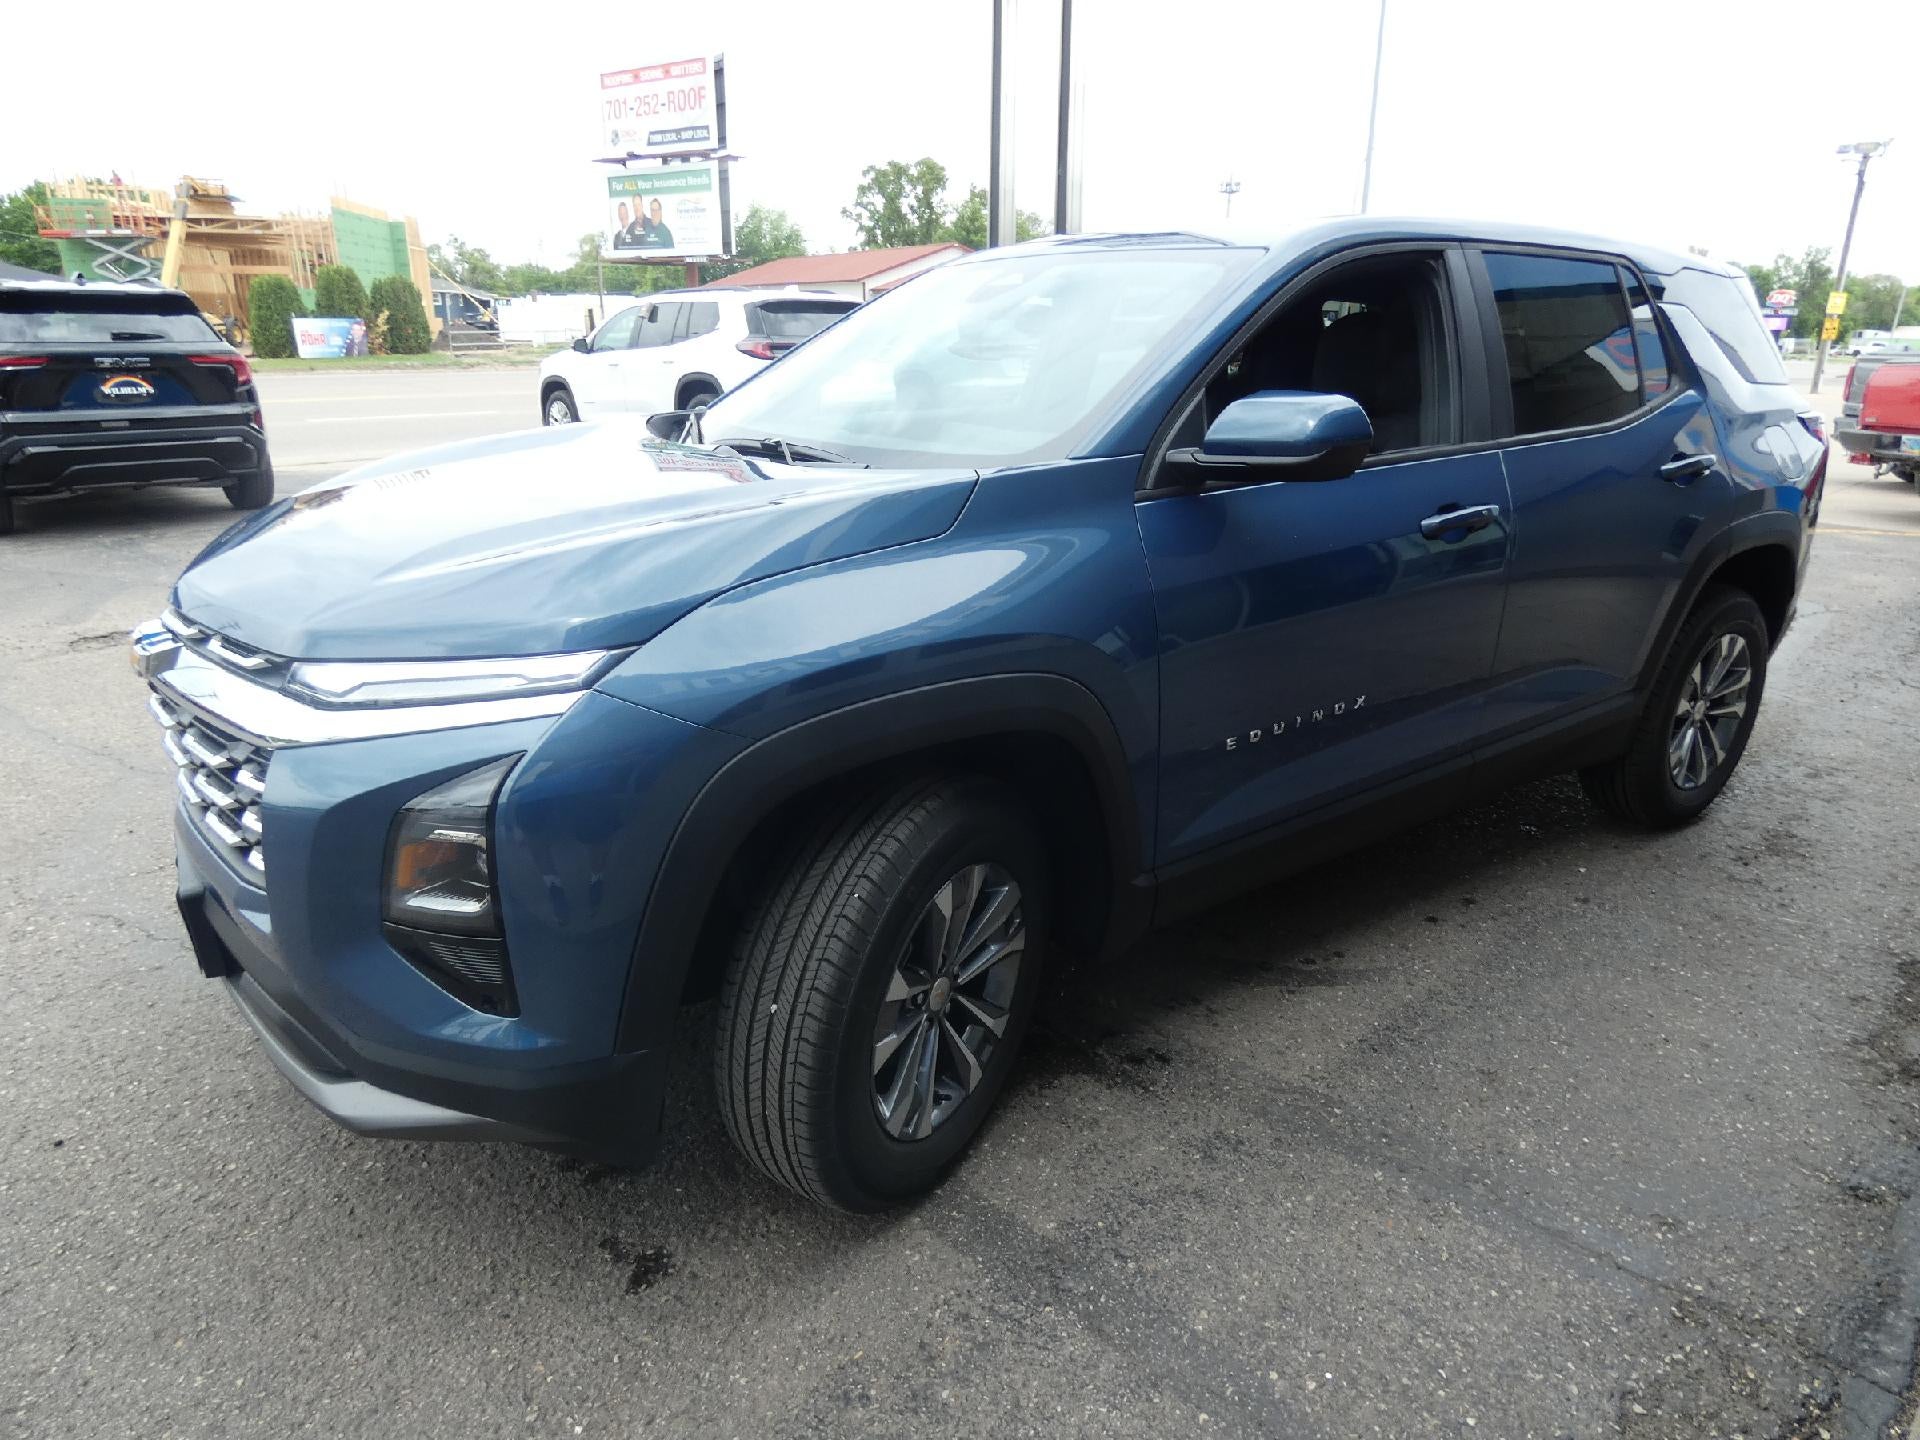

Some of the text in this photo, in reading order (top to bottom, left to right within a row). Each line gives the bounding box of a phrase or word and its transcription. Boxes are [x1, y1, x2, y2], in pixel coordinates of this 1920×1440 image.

[606, 86, 706, 121] 701-252-ROOF
[612, 181, 624, 191] For
[637, 179, 653, 190] Your
[94, 357, 151, 368] GMC
[1225, 695, 1366, 751] EQUINOX
